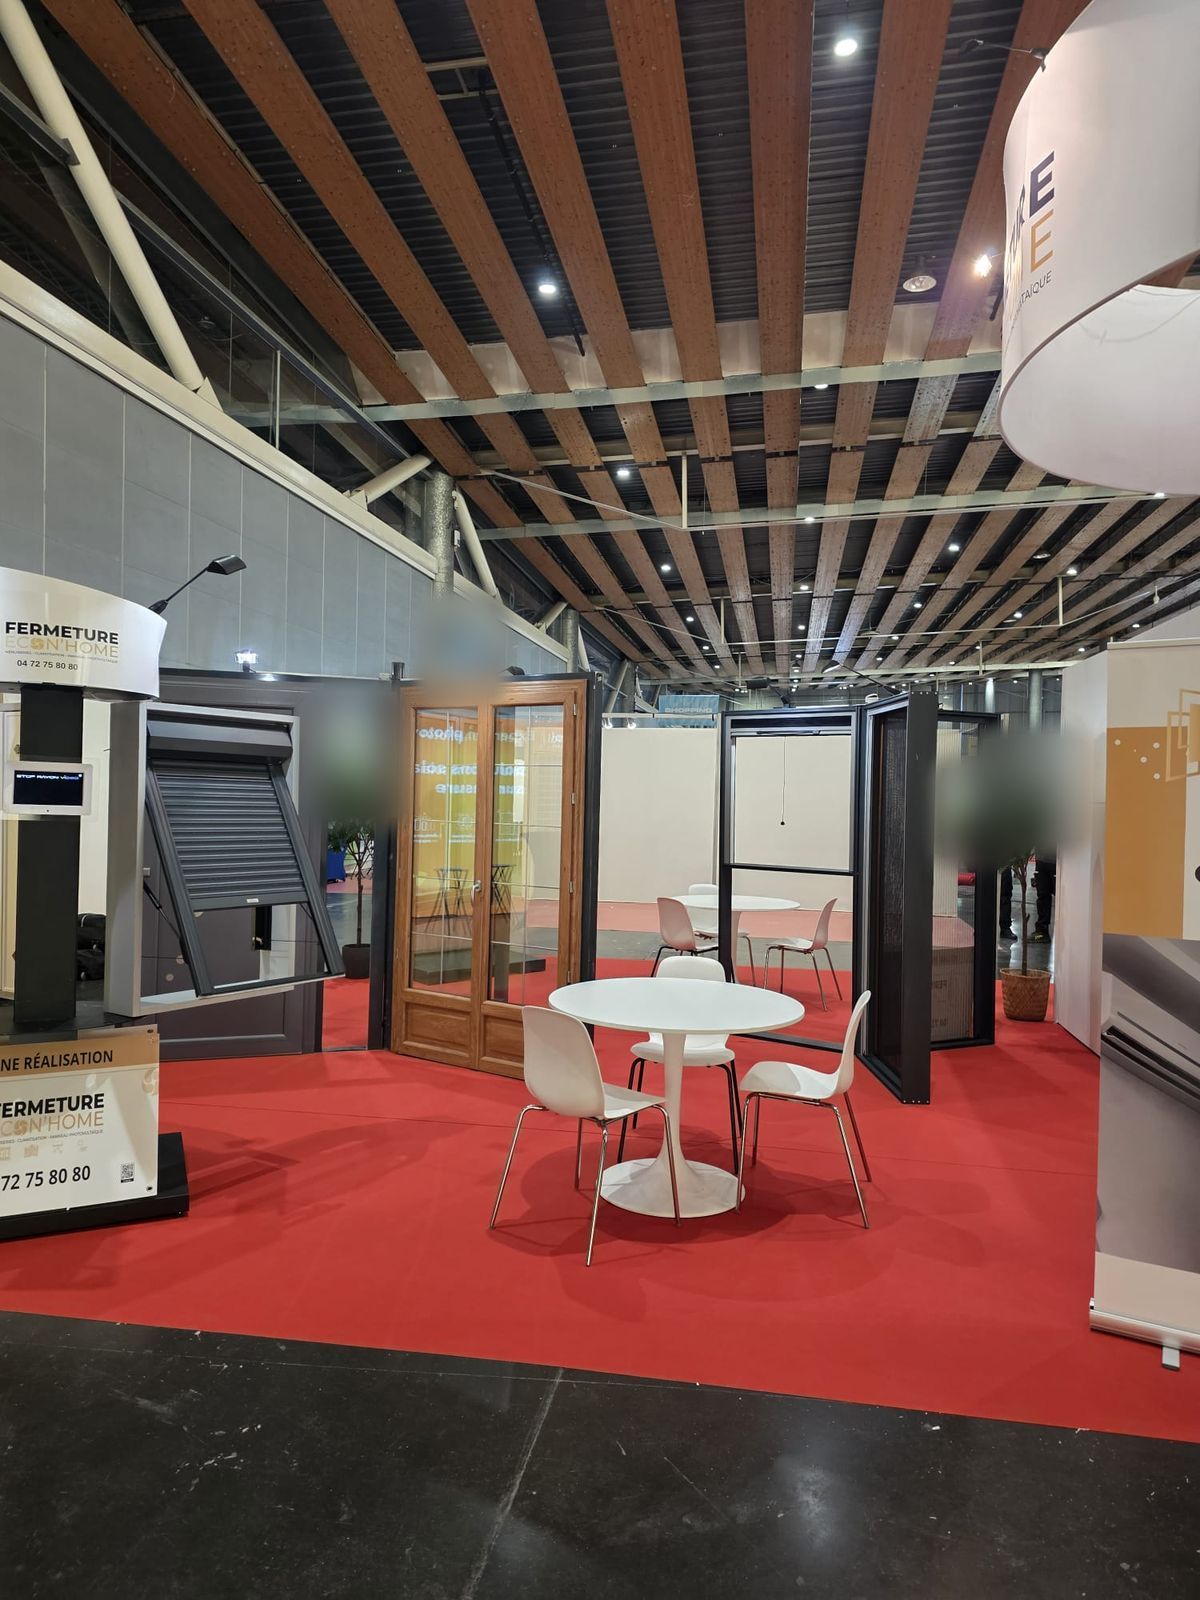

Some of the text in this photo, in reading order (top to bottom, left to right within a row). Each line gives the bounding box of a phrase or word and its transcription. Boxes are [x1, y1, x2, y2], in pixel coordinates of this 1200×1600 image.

[5, 621, 119, 645] FERMETURE
[43, 661, 53, 669] 75
[24, 1050, 113, 1070] RÉALISATION
[0, 1093, 104, 1118] ERMETURE
[1, 1165, 90, 1191] 72 75 80 80
